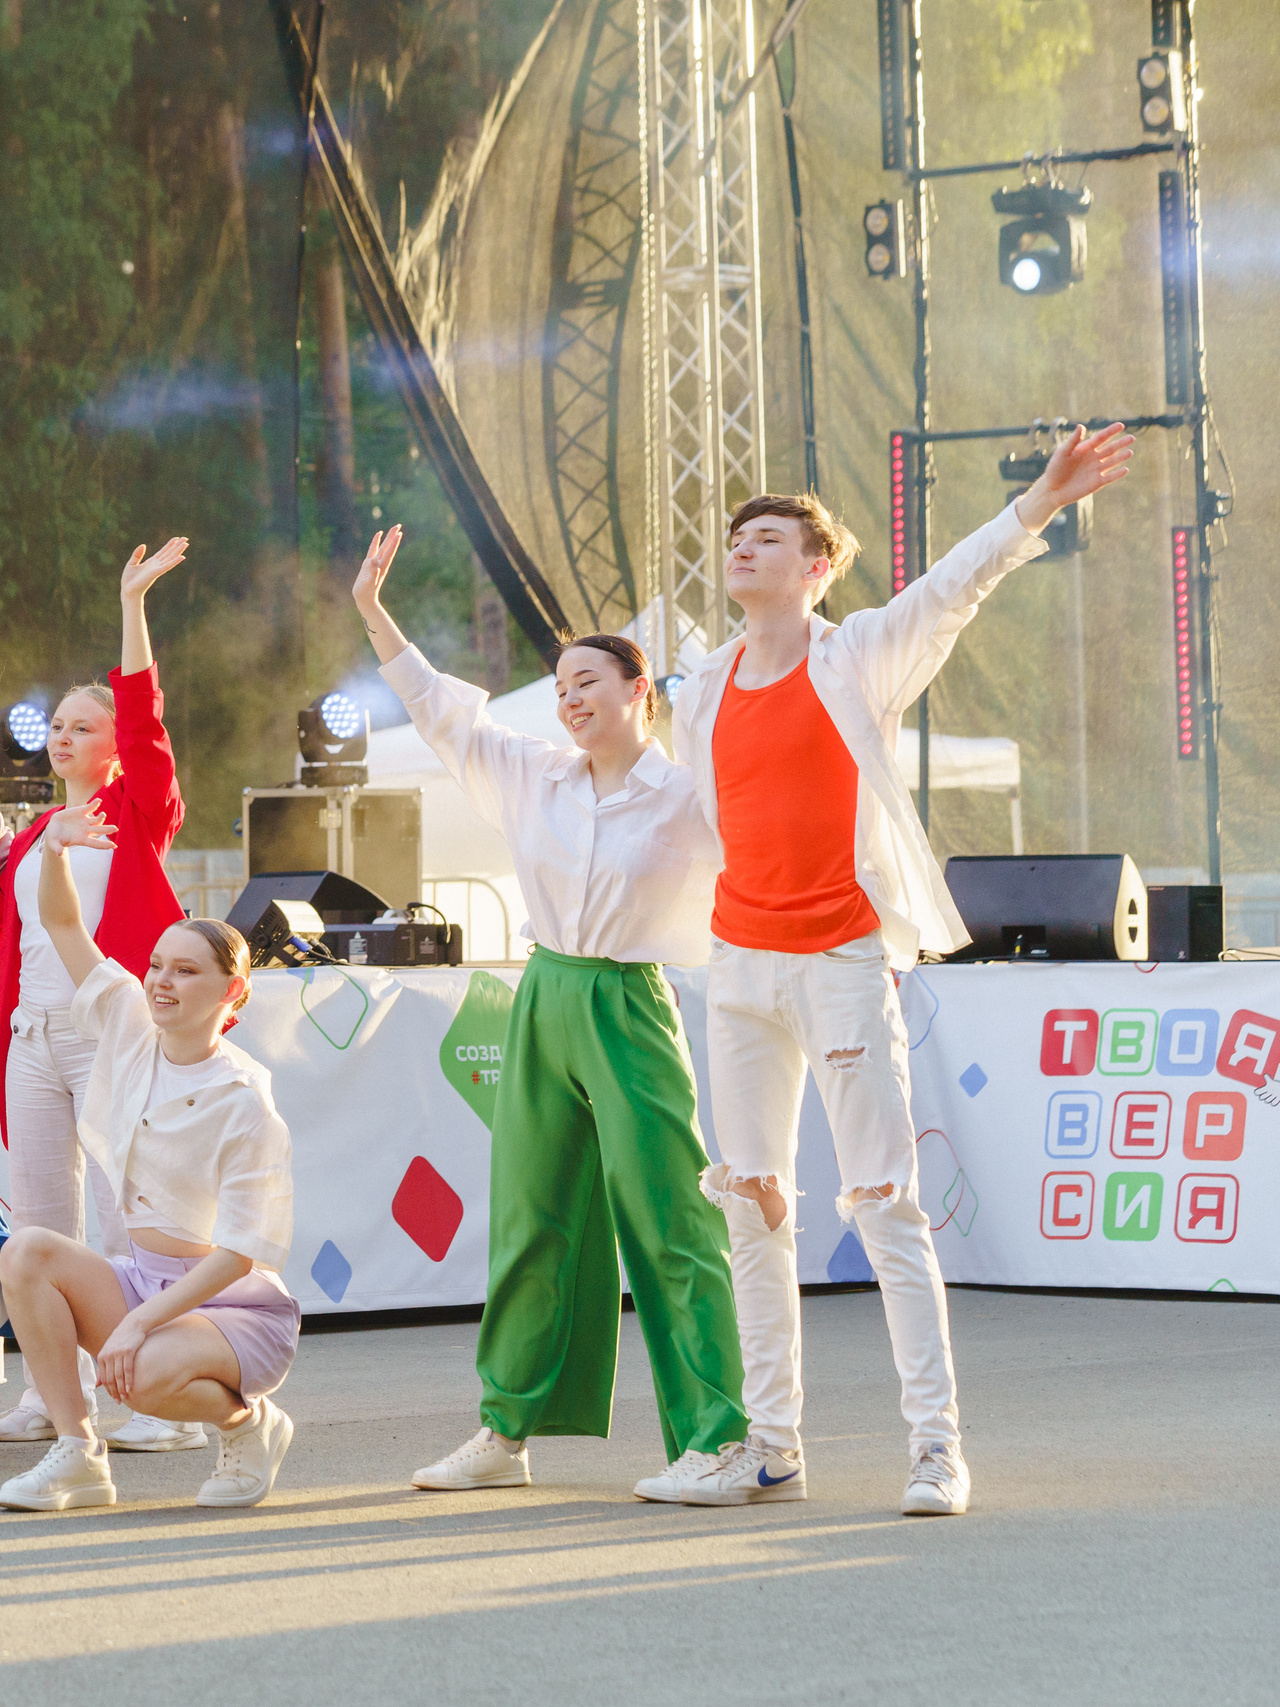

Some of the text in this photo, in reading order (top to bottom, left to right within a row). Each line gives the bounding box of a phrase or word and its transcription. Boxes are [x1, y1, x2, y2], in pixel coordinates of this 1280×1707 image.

[1051, 1018, 1278, 1077] ТВОЯ
[1055, 1102, 1236, 1150] ВЕР
[1051, 1182, 1227, 1232] СИЯ
